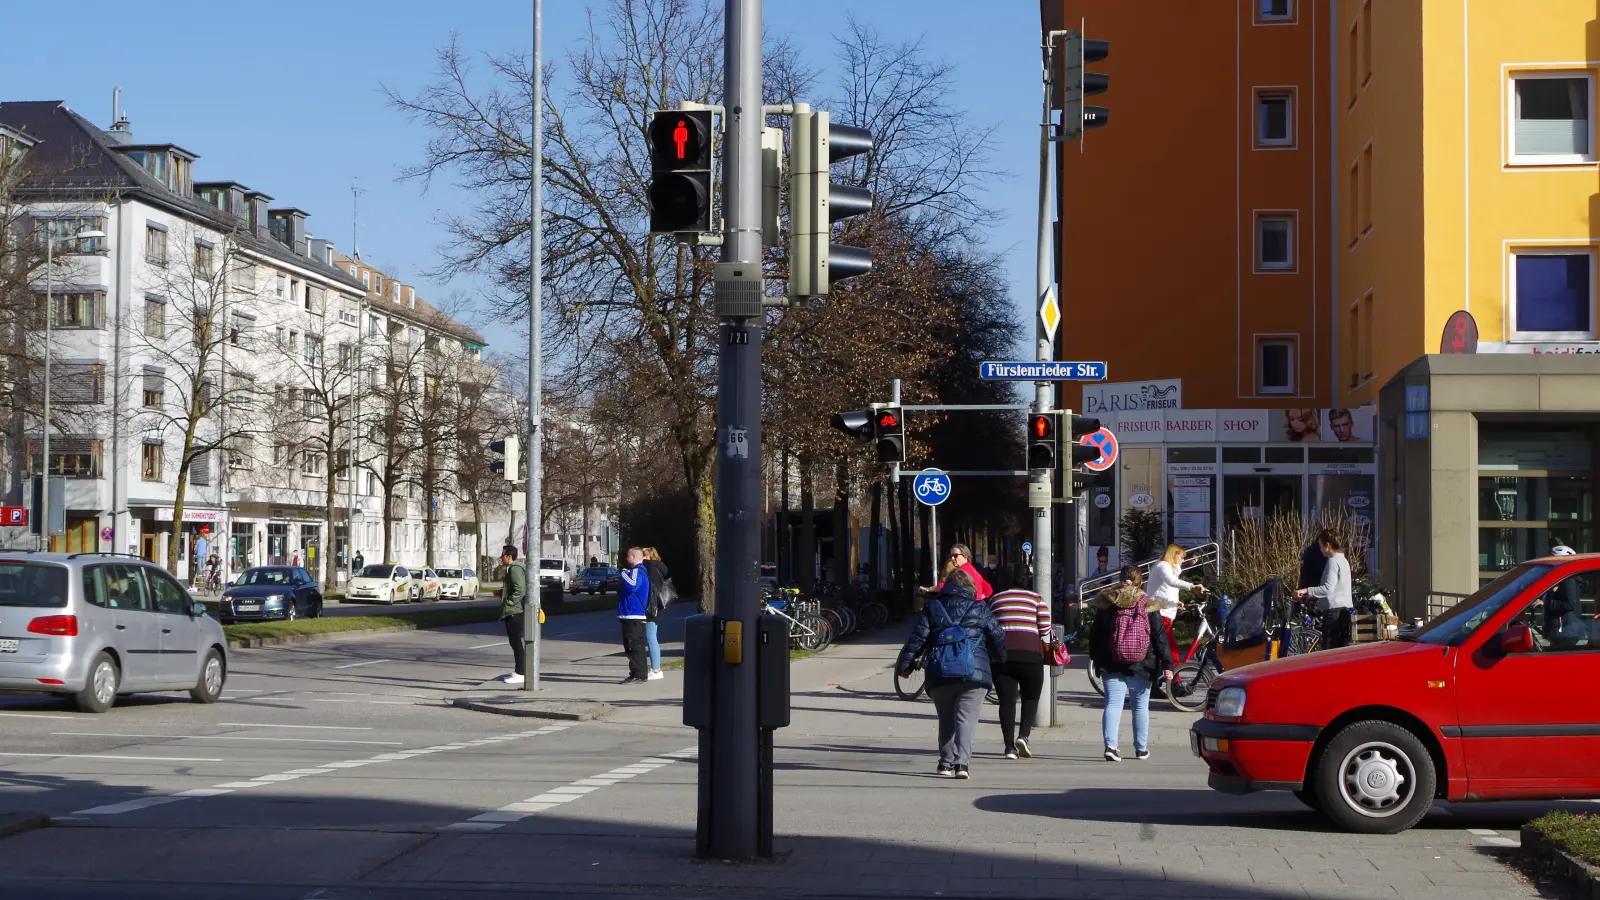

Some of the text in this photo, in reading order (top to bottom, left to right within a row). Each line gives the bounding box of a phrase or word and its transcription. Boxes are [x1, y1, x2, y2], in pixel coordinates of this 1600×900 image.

[730, 333, 747, 344] 721
[988, 363, 1099, 377] Fürstenrieder Str.
[1087, 390, 1138, 412] PARIS
[1147, 399, 1177, 410] FRISEUR
[1118, 421, 1161, 432] FRISEUR
[1166, 420, 1213, 431] BARBER
[1223, 420, 1259, 431] SHOP
[731, 433, 743, 443] 66
[13, 511, 20, 520] P
